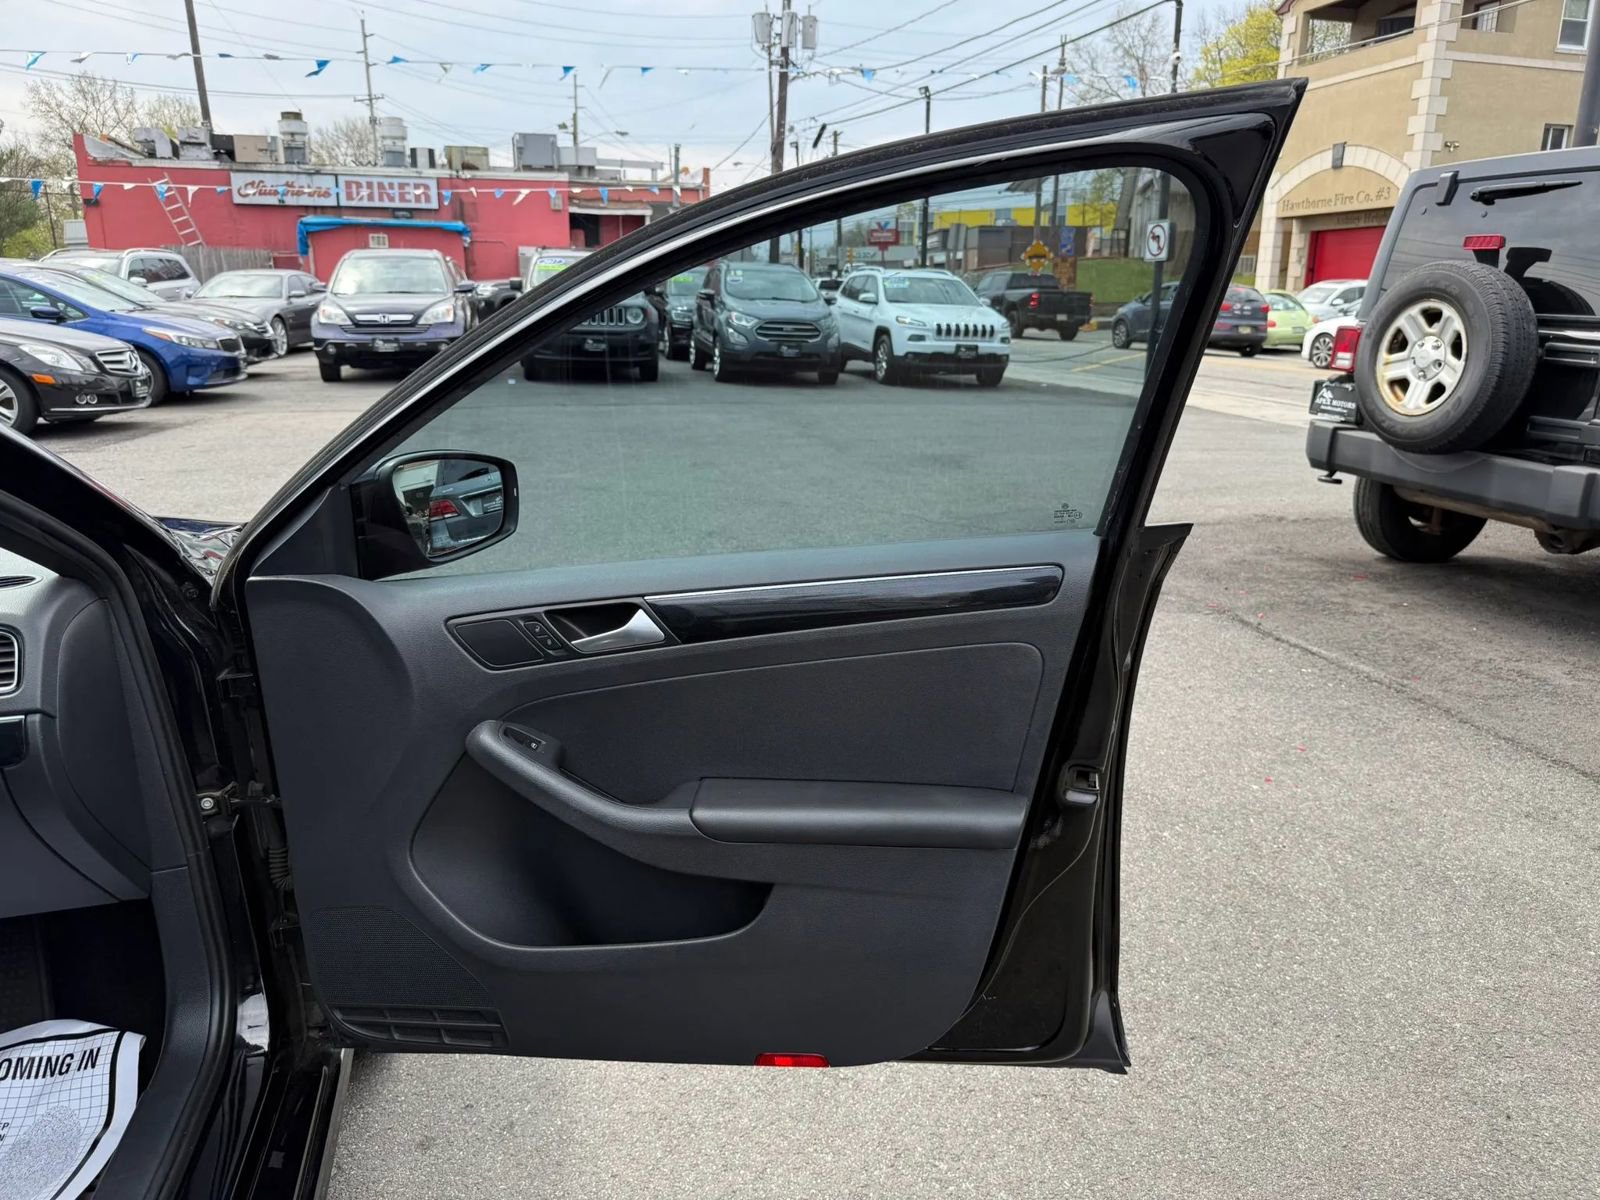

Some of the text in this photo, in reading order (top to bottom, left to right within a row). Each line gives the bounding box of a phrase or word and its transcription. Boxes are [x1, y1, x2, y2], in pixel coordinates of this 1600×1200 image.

[345, 181, 432, 204] DINER
[1281, 187, 1391, 212] Hawthorne Fire Co. #3
[1332, 399, 1356, 409] MOTORS
[77, 1046, 101, 1071] IN
